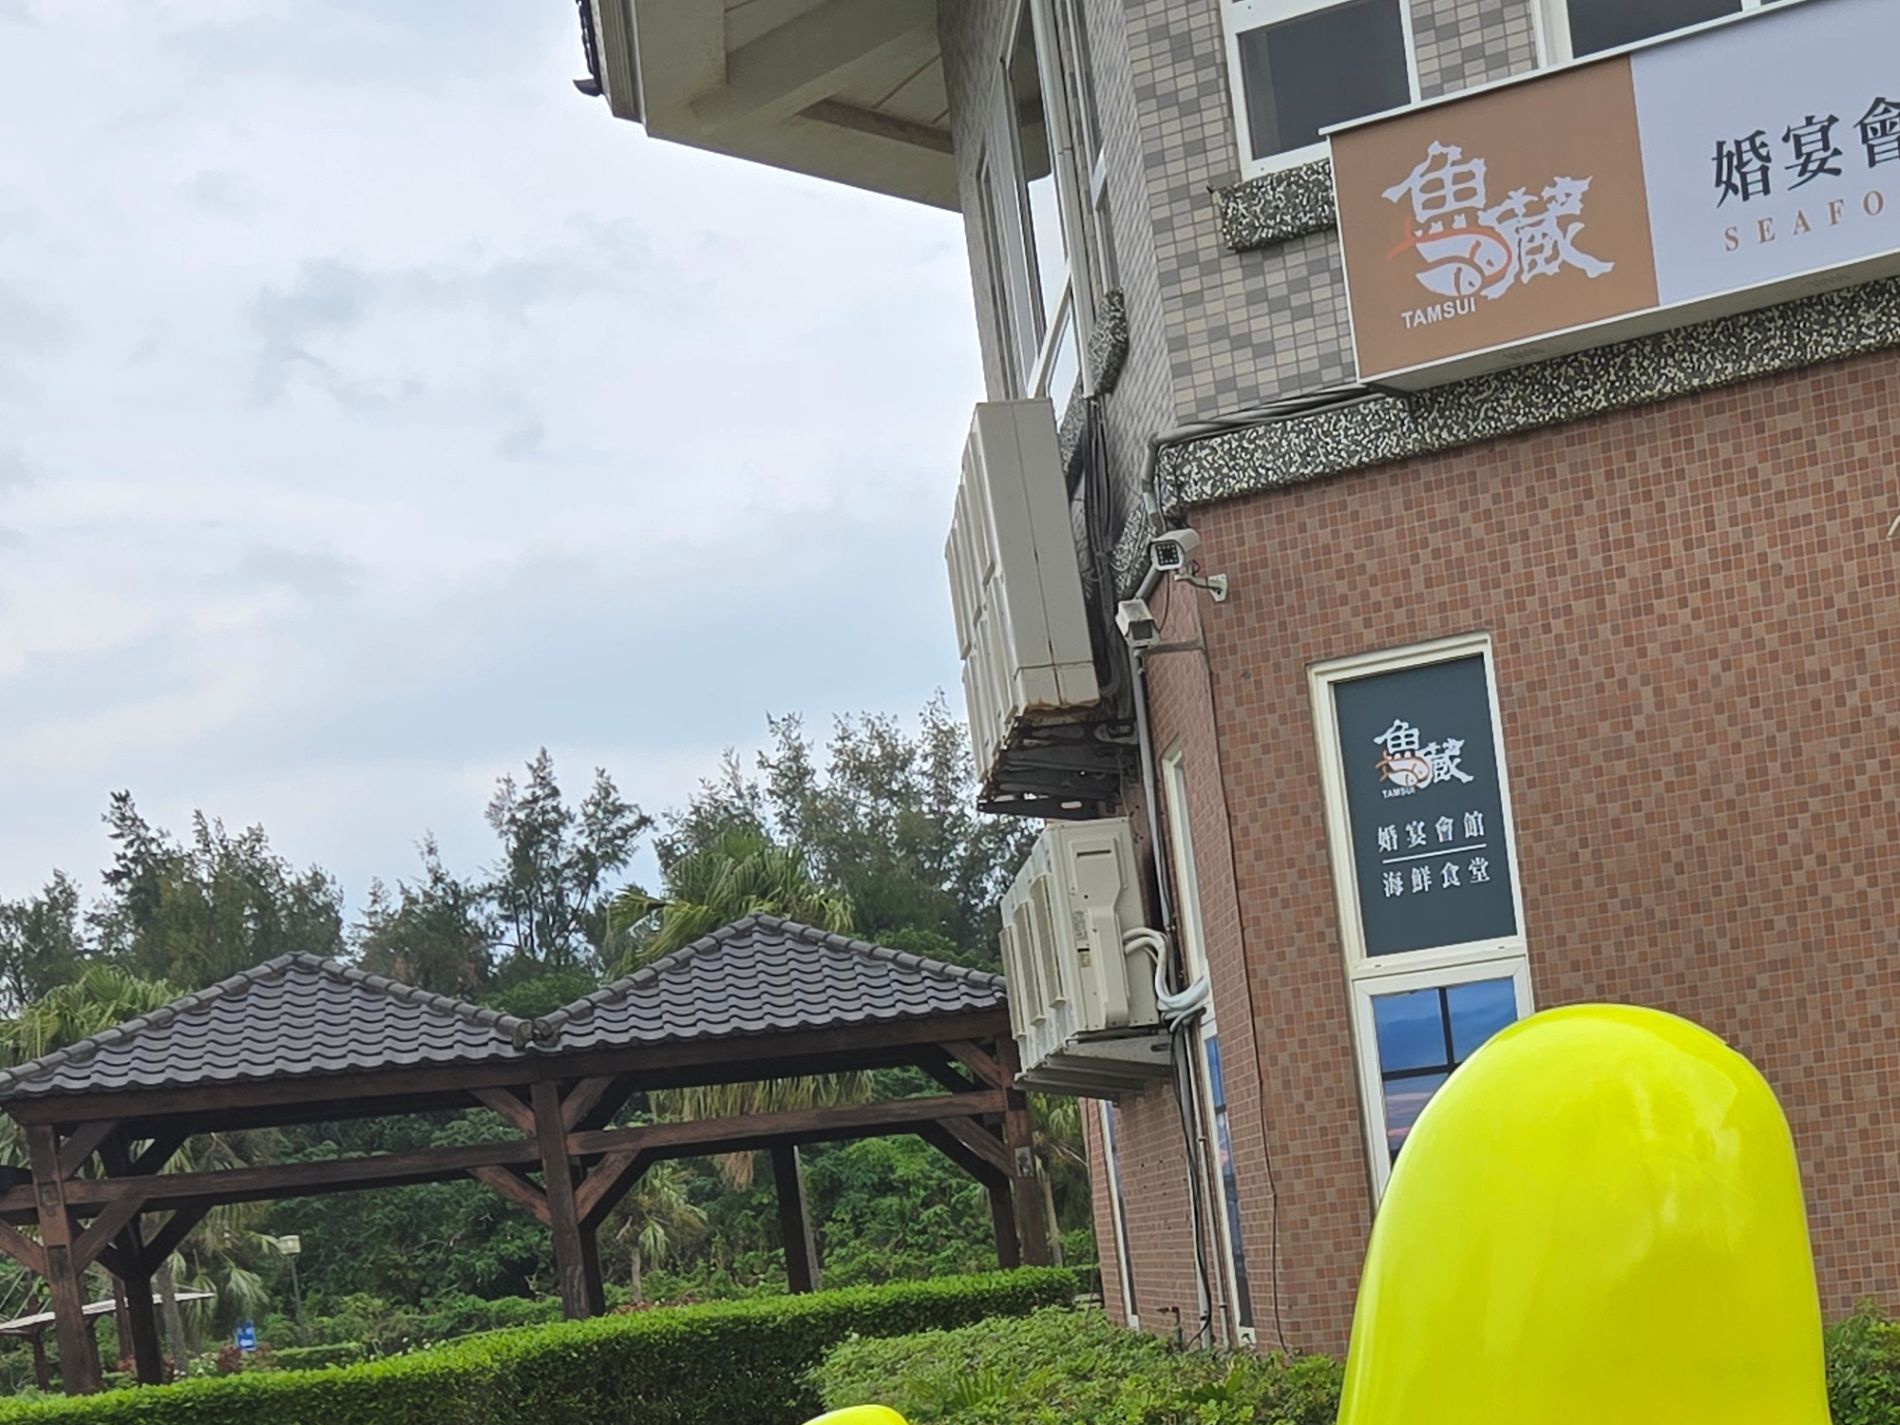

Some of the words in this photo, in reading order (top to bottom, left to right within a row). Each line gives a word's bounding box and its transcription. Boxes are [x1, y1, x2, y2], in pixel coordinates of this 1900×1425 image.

[1401, 297, 1476, 329] TAMSUI
[1381, 786, 1417, 799] TAMSUI
[1377, 810, 1486, 853] 婚宴會館
[1382, 856, 1491, 898] 海鮮食堂
